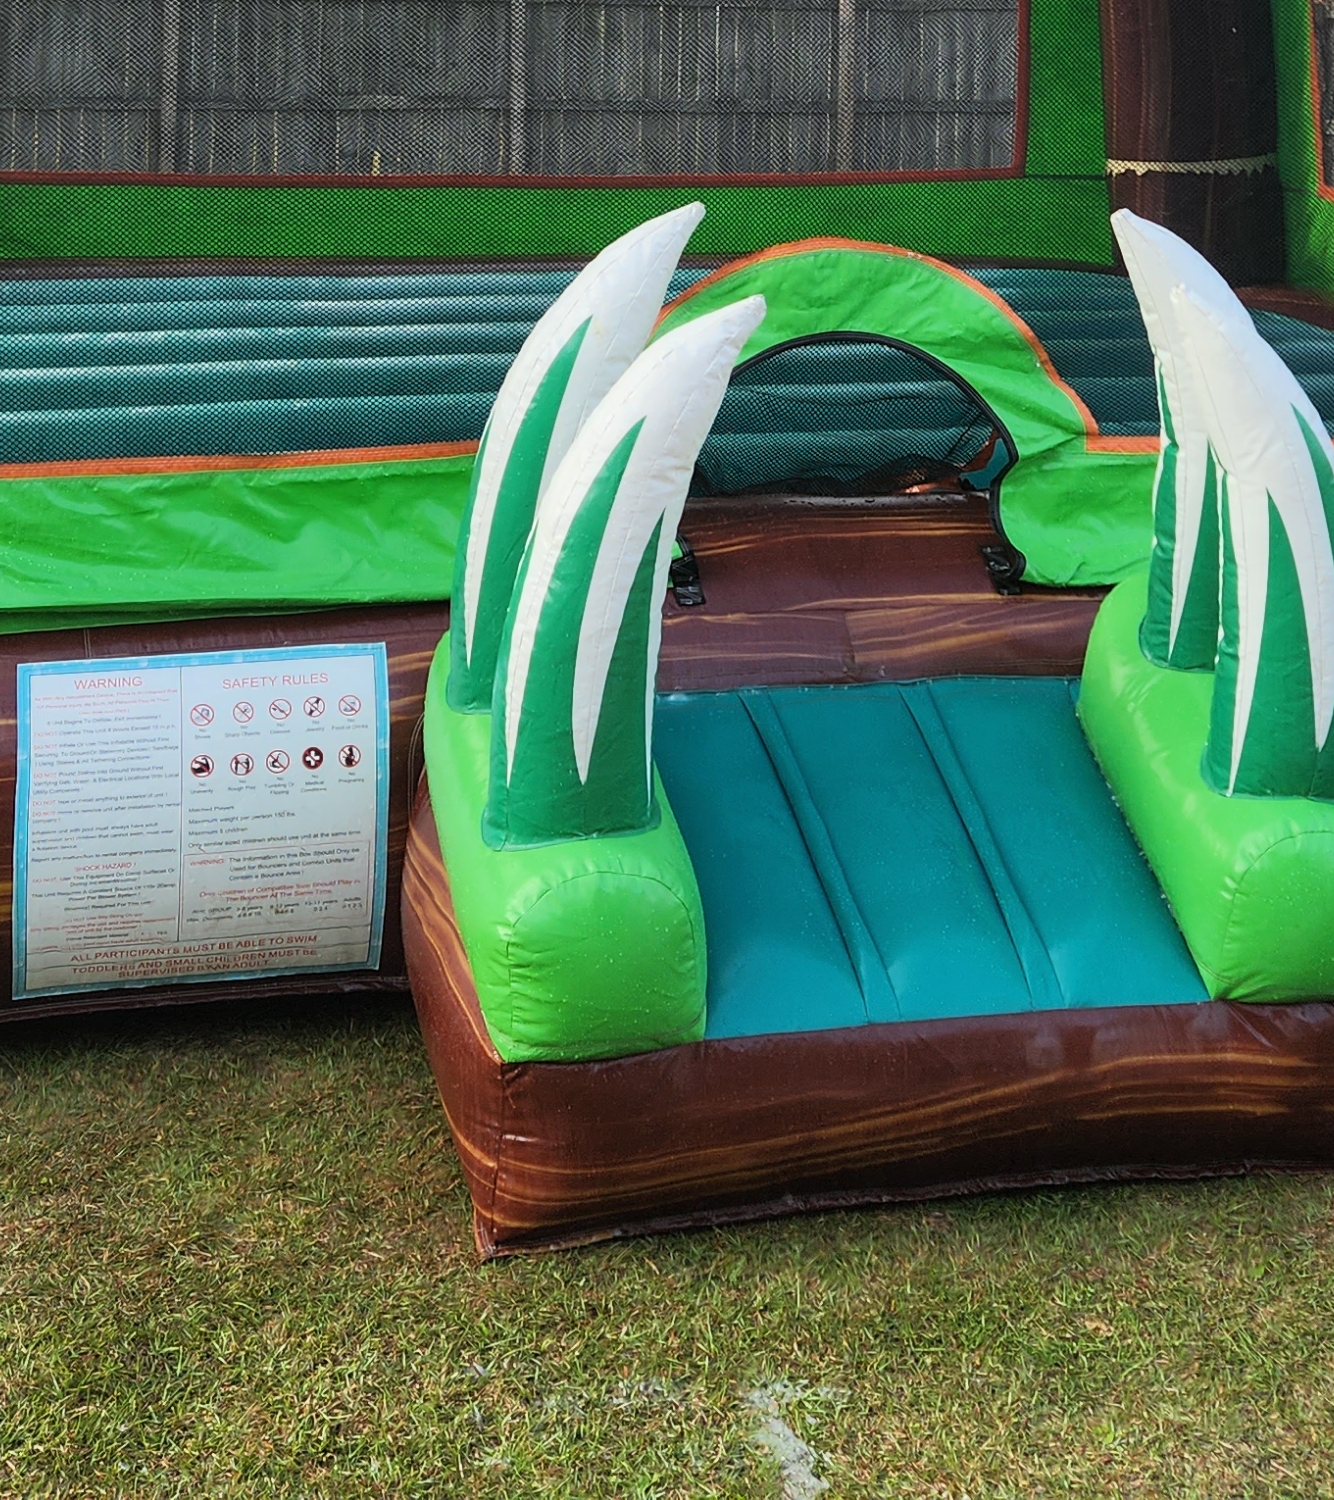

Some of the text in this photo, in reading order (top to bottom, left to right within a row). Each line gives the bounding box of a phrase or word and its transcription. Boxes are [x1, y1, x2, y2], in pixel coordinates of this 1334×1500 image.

[74, 676, 143, 690] WARNING
[223, 673, 329, 689] SAFETY RULES
[71, 953, 92, 962] ALL
[183, 943, 217, 953] MUST
[219, 942, 233, 950] BE
[236, 939, 265, 948] ABLE
[269, 937, 284, 945] TO
[138, 961, 162, 969] AND
[268, 949, 300, 958] MUST
